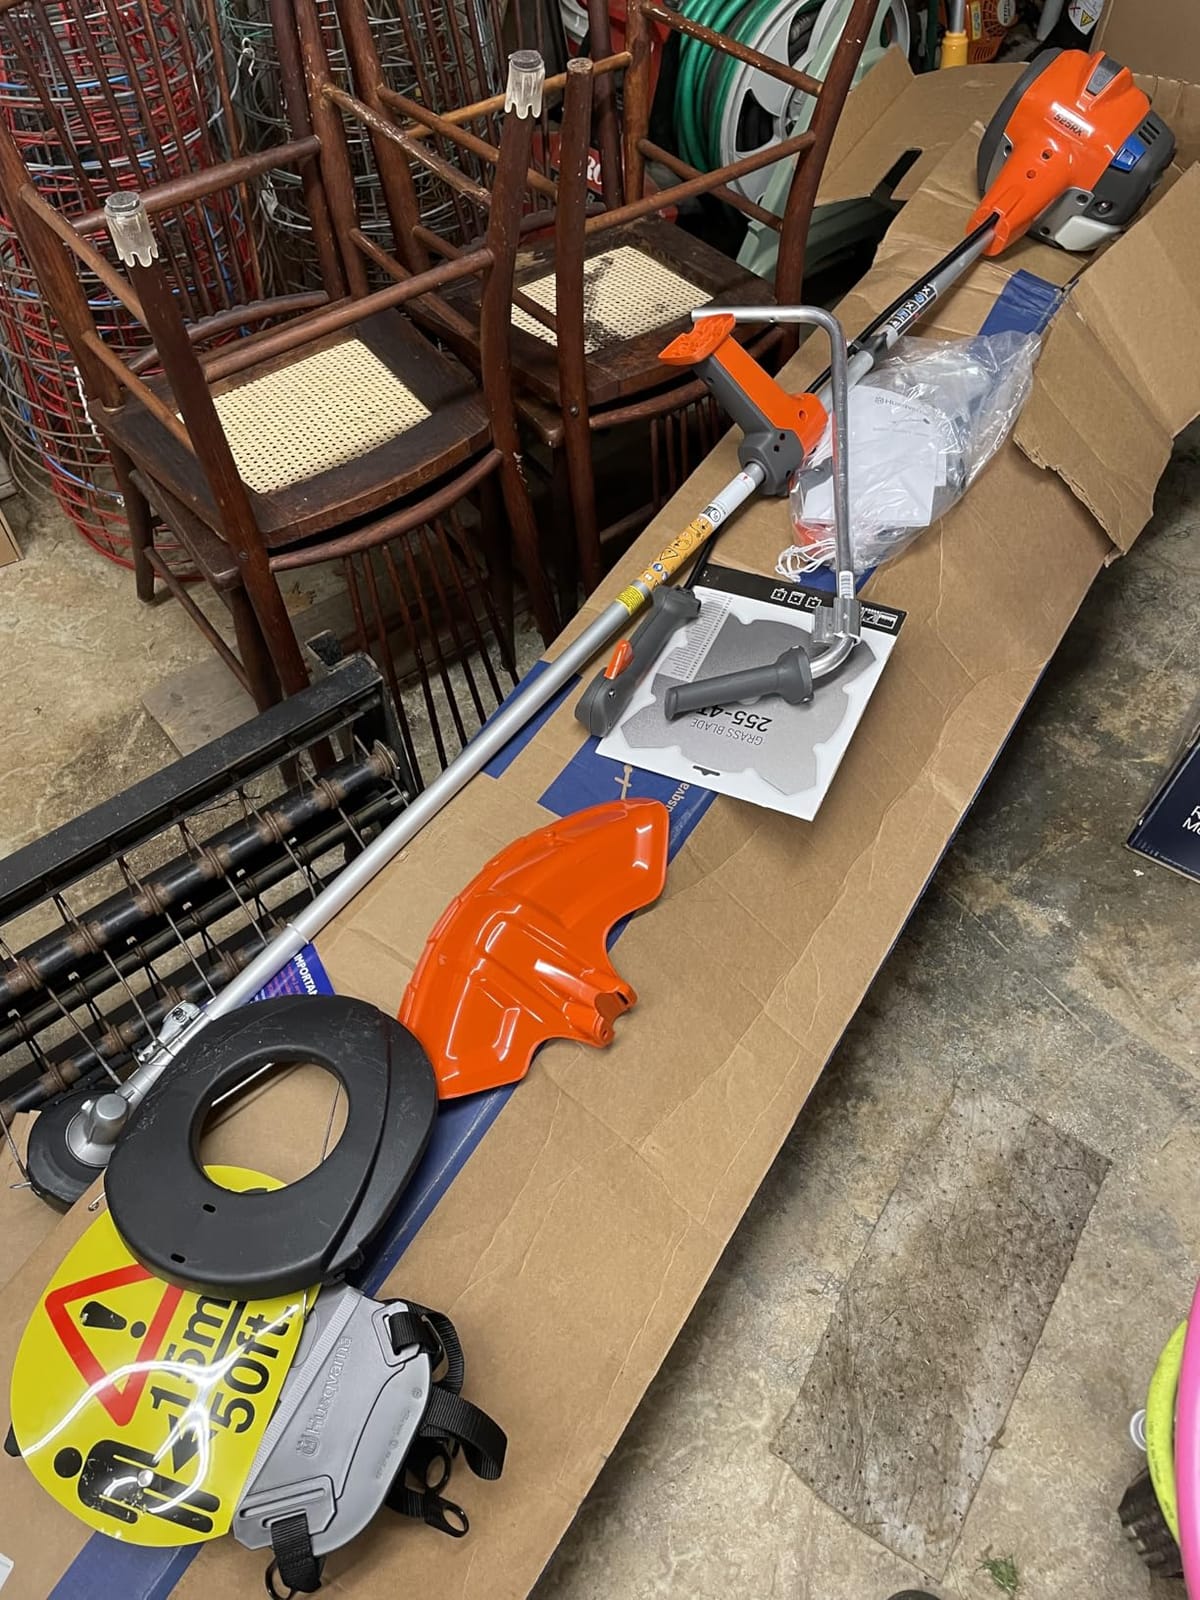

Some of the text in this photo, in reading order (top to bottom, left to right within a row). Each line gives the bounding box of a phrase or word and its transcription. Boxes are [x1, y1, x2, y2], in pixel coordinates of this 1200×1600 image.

[690, 717, 764, 746] GRASS BLADE
[304, 1335, 353, 1436] Husqvarna
